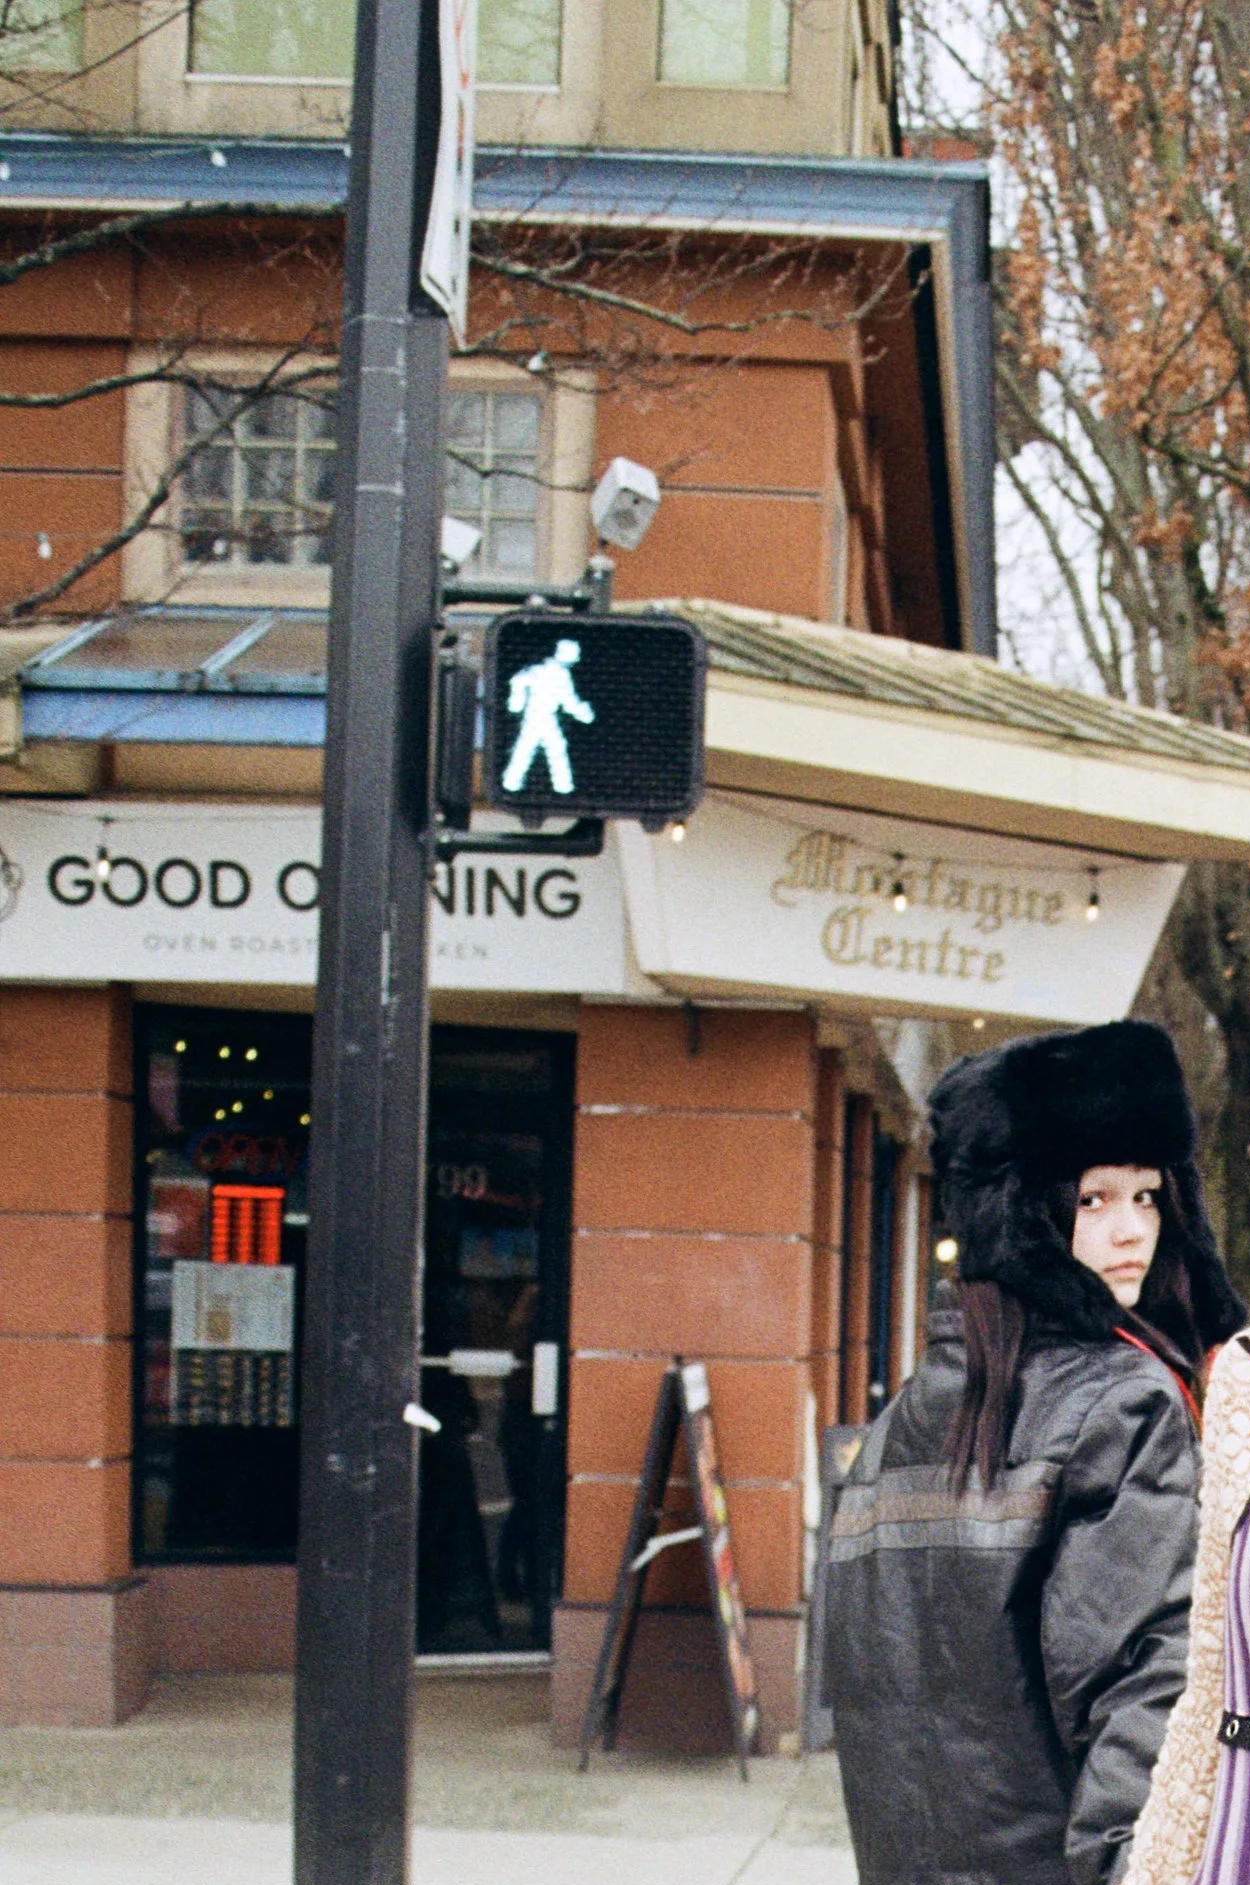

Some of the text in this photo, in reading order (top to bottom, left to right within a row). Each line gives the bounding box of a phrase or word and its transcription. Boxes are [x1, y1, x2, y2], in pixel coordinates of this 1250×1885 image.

[48, 855, 581, 919] GOOD ONING
[143, 933, 318, 956] OVEN ROAST
[820, 905, 1004, 982] Centre
